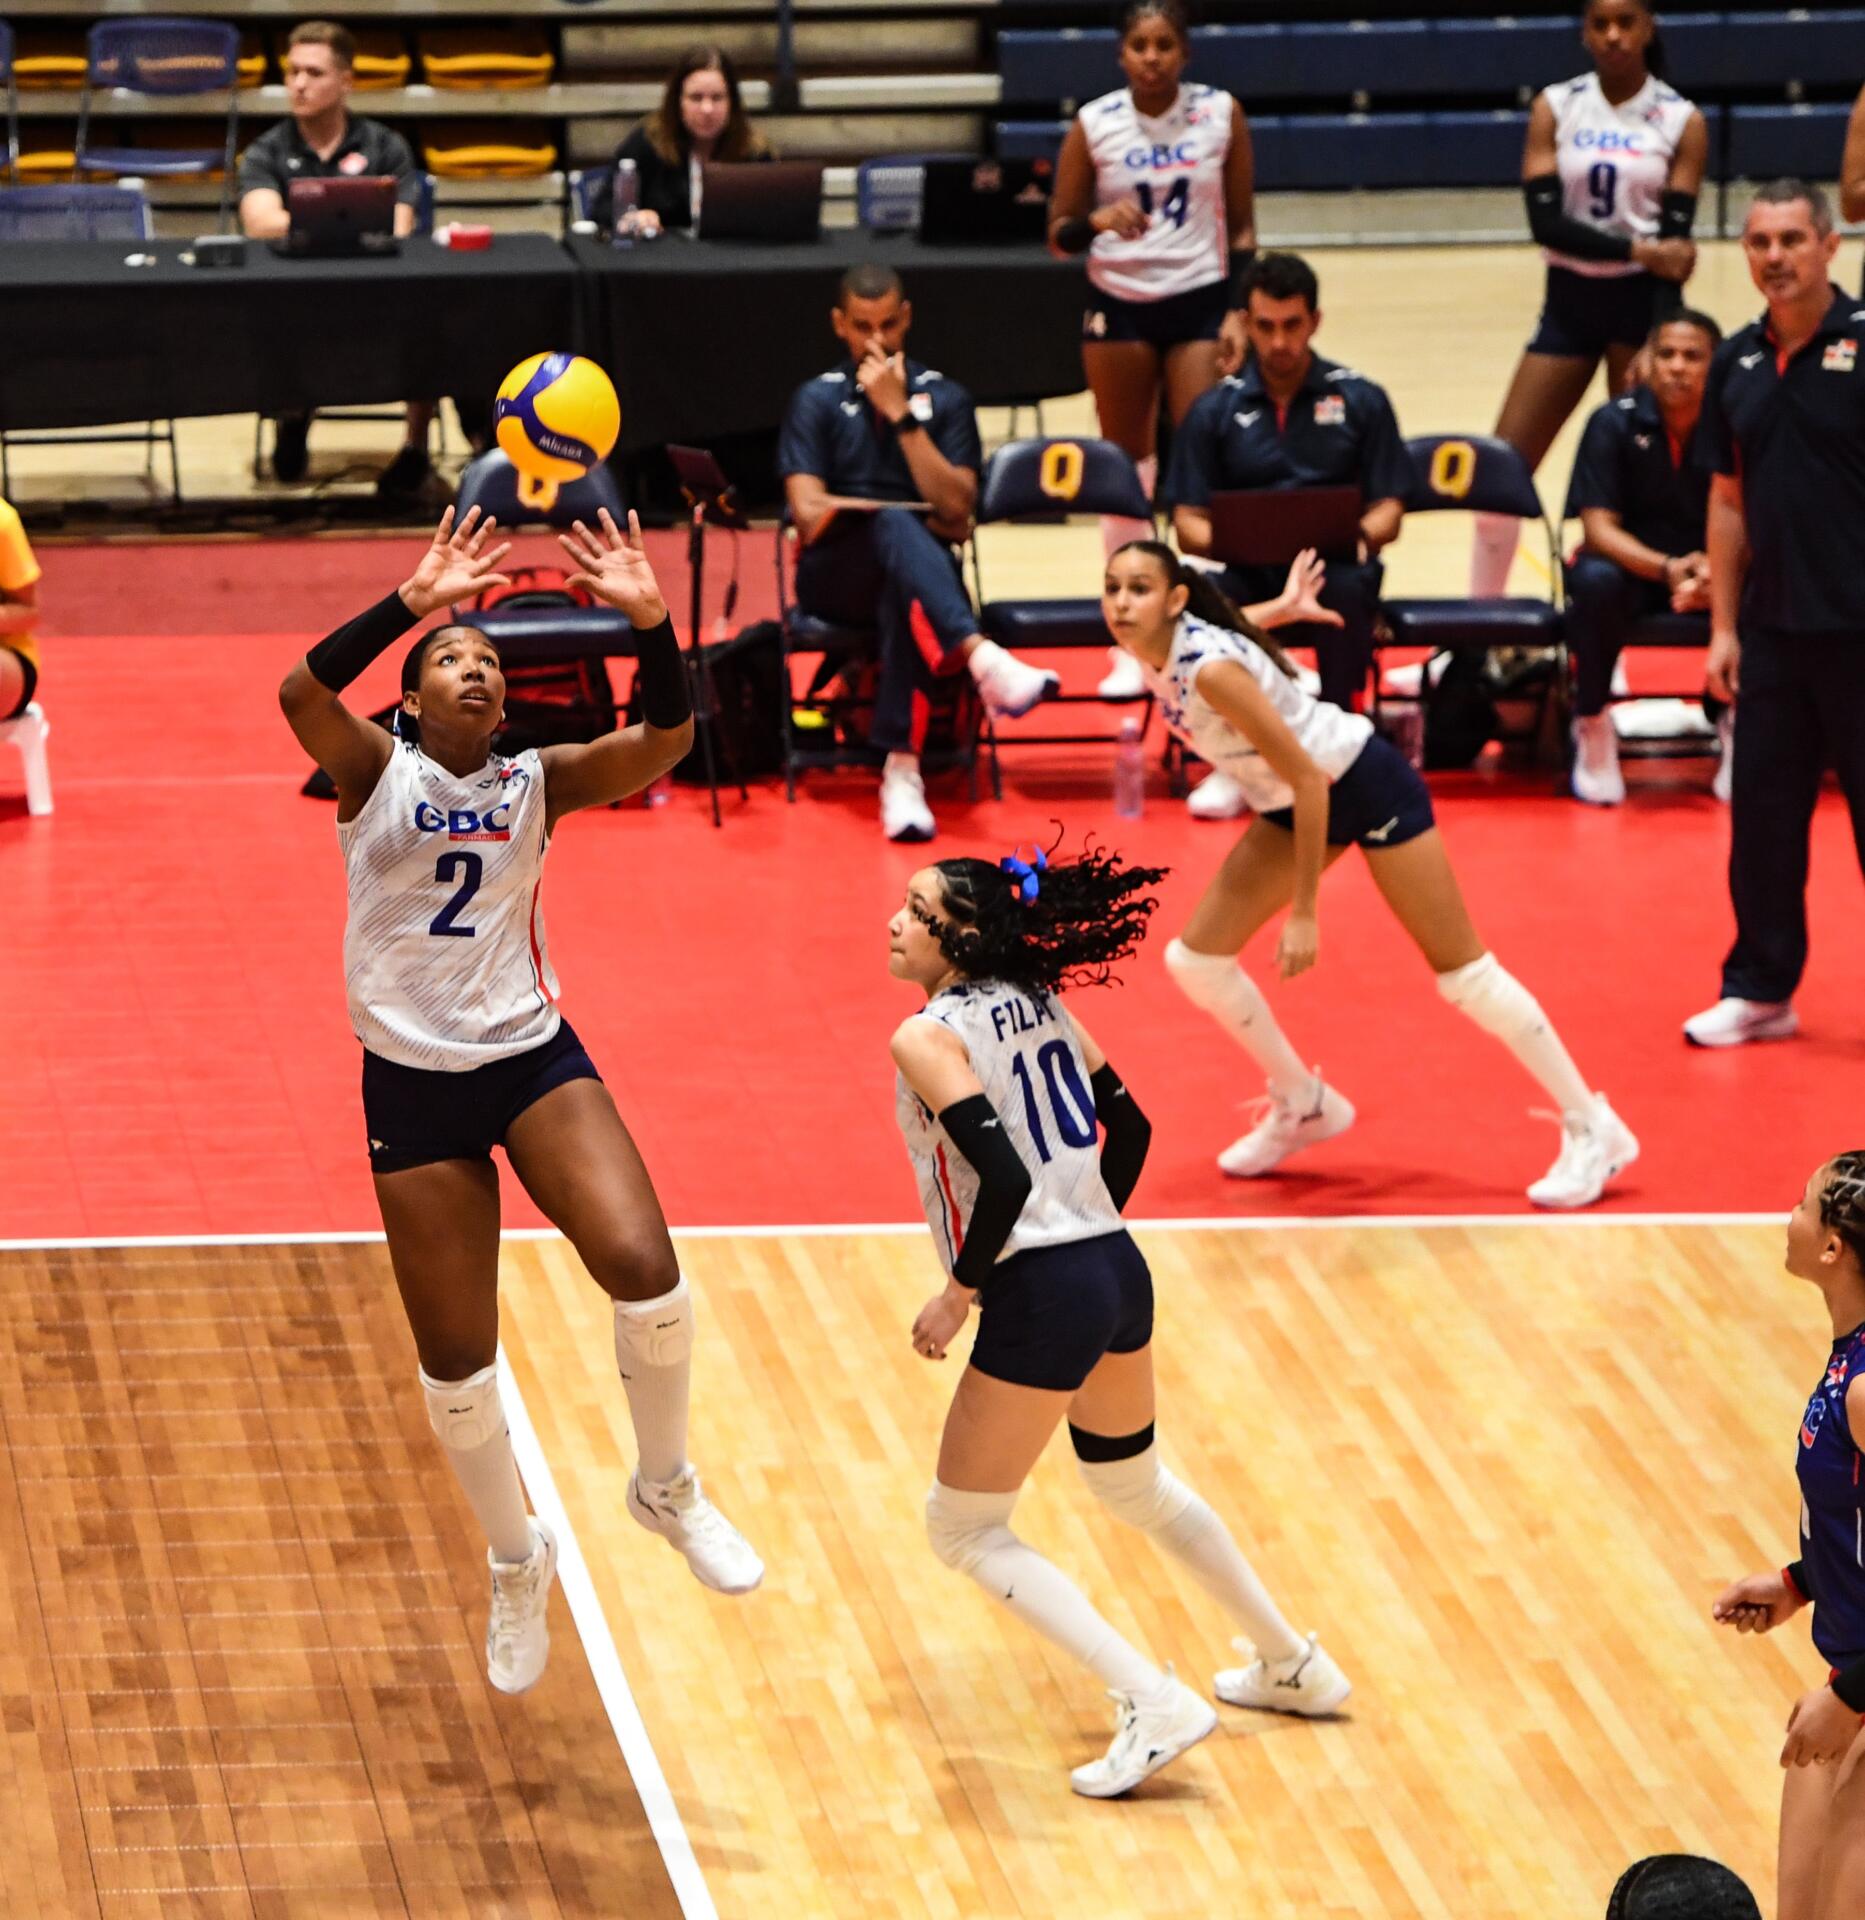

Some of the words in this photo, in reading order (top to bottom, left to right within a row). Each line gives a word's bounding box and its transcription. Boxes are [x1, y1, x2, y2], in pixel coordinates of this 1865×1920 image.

[1124, 141, 1196, 169] GBC
[1574, 128, 1644, 151] GBC
[1135, 176, 1190, 229] 14
[1588, 162, 1618, 219] 9
[1040, 442, 1085, 502] Q
[1429, 440, 1477, 500] Q
[415, 800, 511, 834] GBC
[428, 850, 483, 938] 2
[1012, 1038, 1098, 1165] 10
